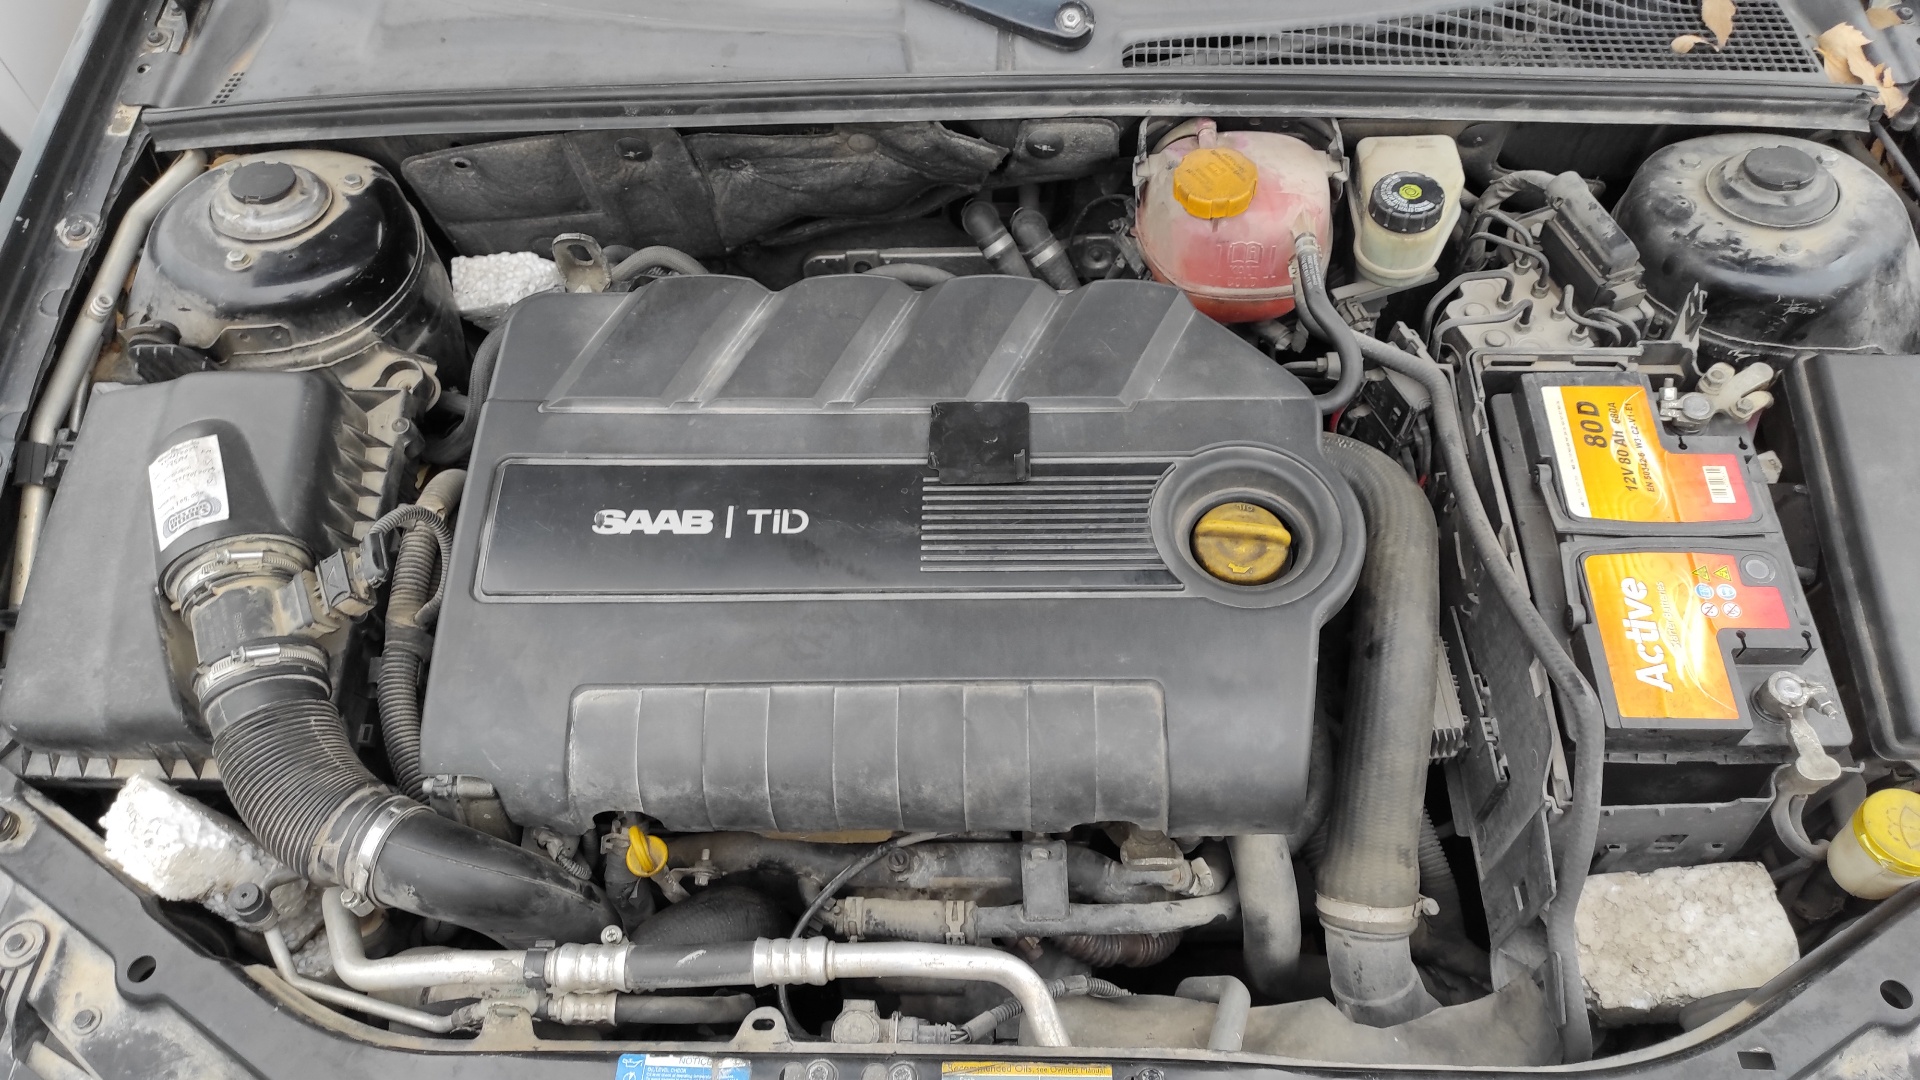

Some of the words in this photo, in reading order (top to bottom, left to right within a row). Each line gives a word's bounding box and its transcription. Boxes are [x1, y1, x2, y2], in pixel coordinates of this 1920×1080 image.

[1607, 402, 1621, 424] 680A
[1611, 430, 1628, 448] Ah
[1616, 449, 1632, 465] 80
[1620, 466, 1639, 492] 12V
[1645, 481, 1656, 493] EN
[592, 509, 715, 535] SAAB
[1655, 581, 1673, 617] Batteries
[1620, 577, 1675, 693] Active
[1666, 619, 1682, 648] Starter
[1036, 1066, 1048, 1074] see
